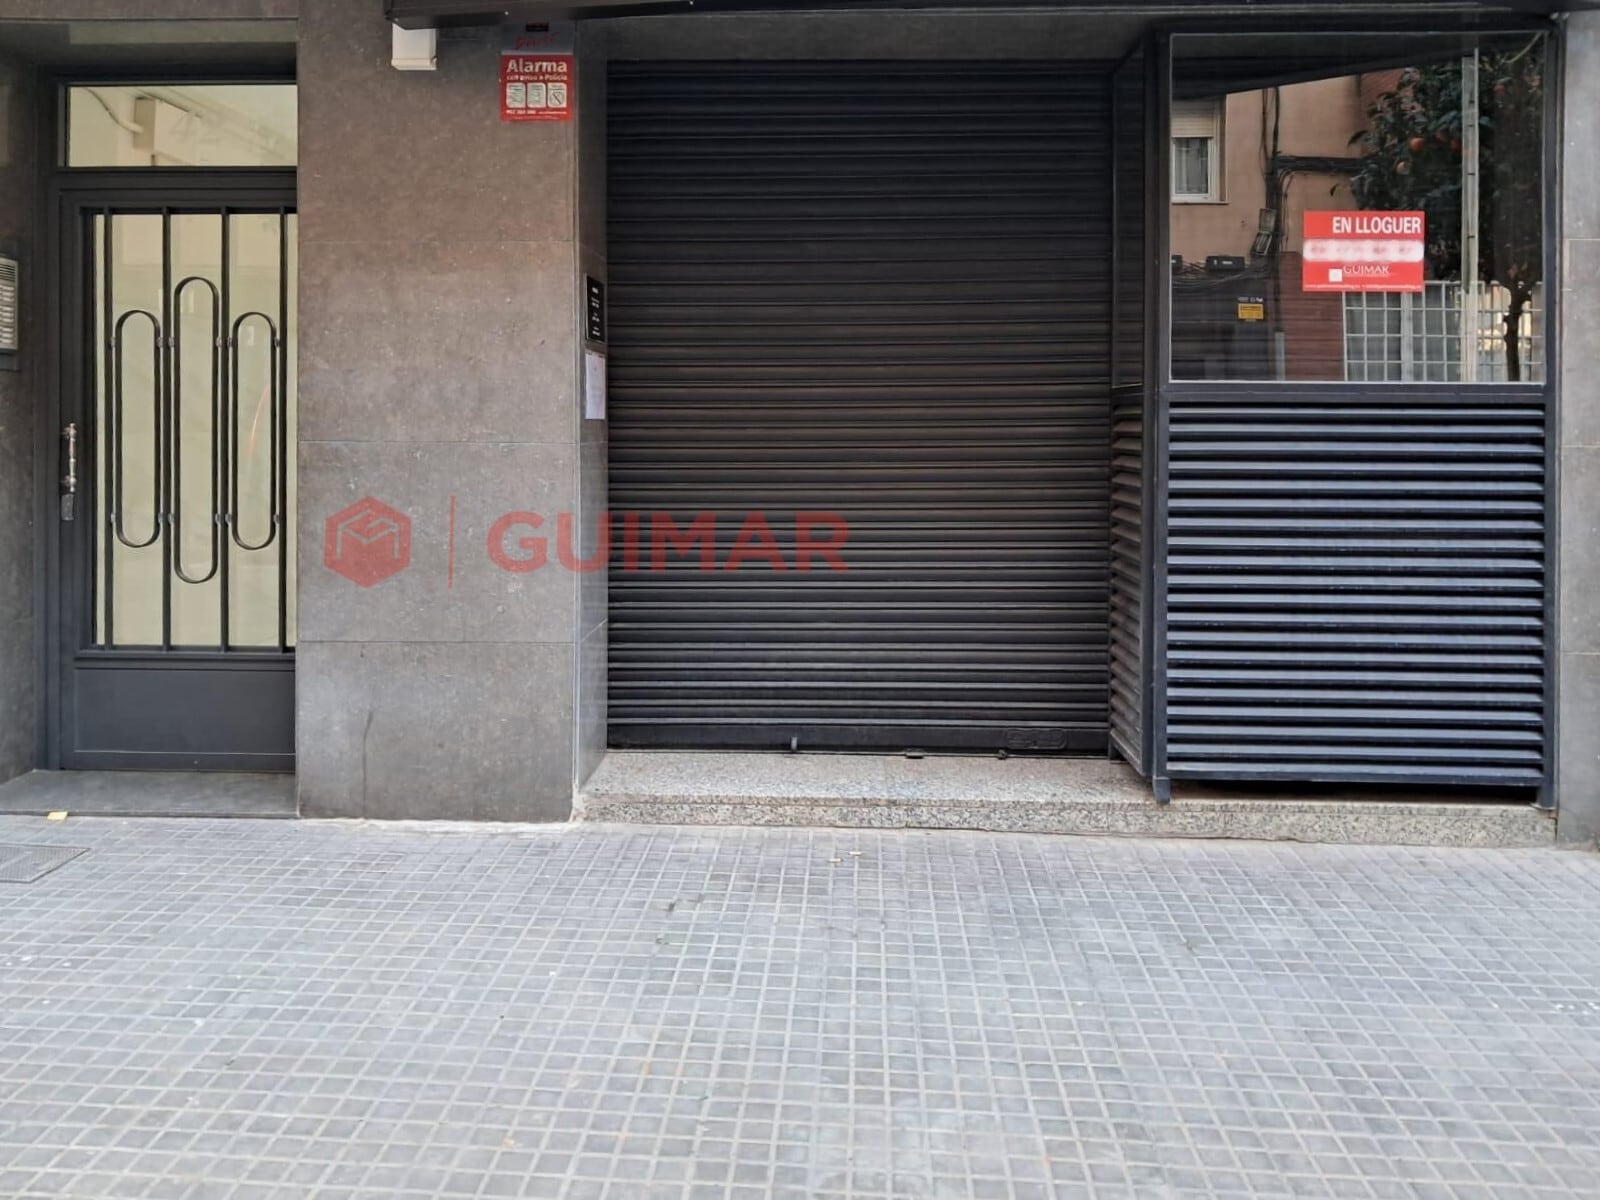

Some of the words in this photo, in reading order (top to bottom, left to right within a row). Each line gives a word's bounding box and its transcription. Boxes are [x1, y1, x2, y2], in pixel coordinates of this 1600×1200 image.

[506, 58, 568, 73] Alarma
[1332, 217, 1352, 234] EN
[1355, 217, 1422, 234] LLOGUER
